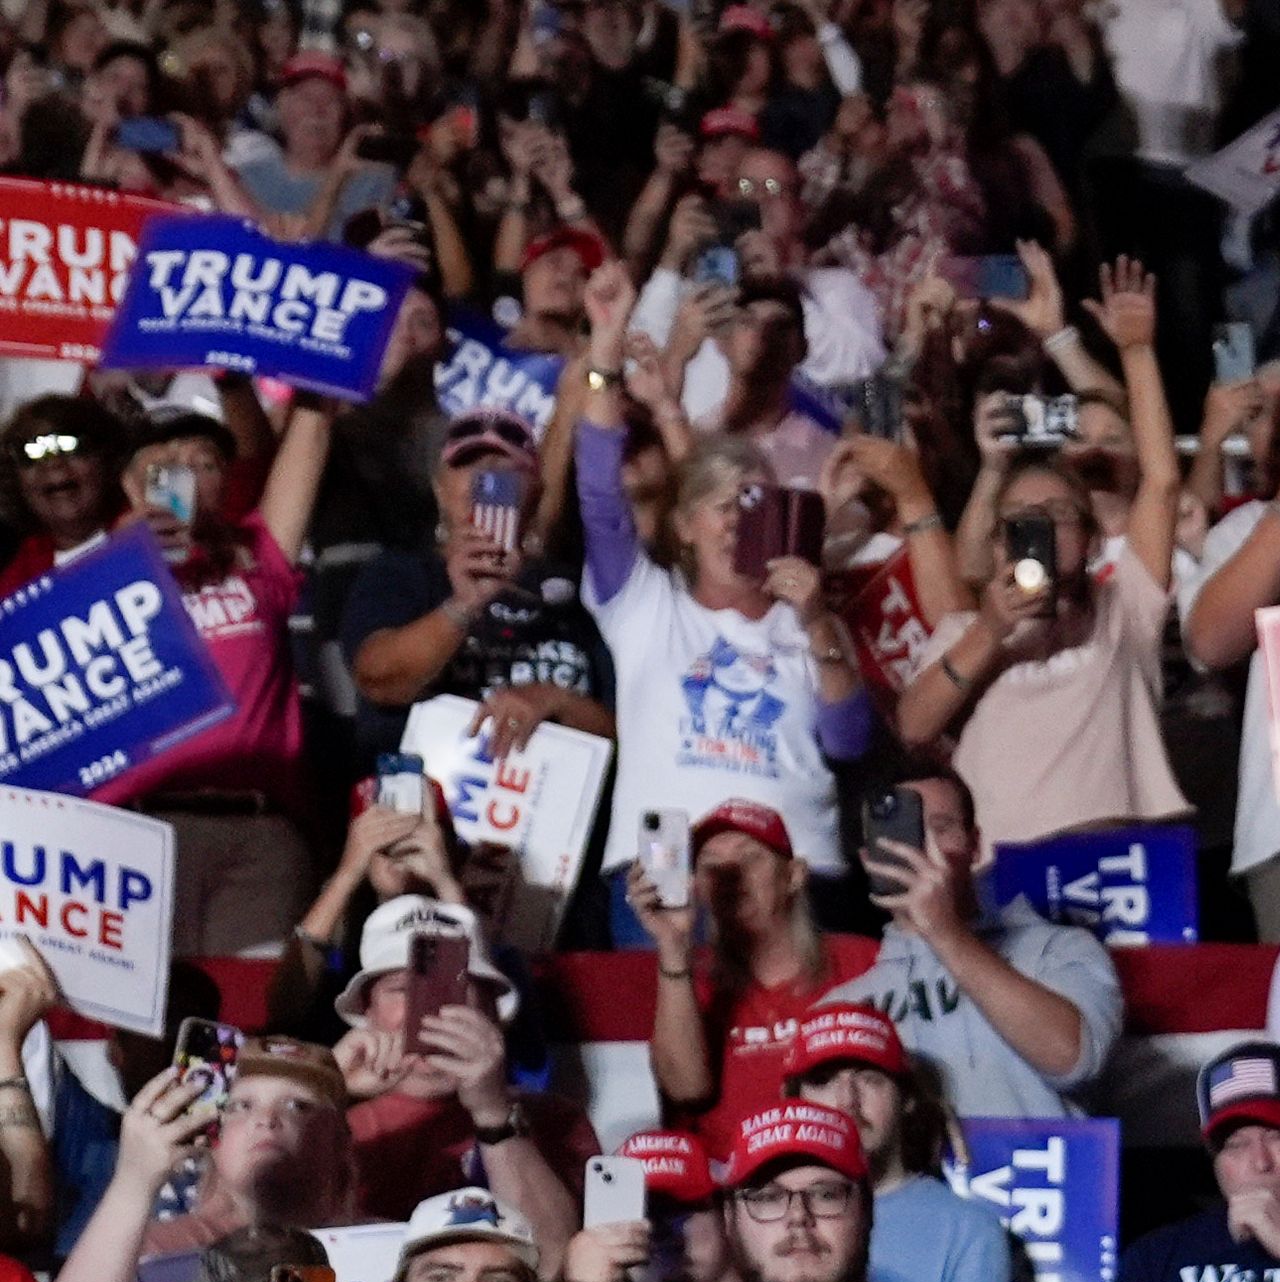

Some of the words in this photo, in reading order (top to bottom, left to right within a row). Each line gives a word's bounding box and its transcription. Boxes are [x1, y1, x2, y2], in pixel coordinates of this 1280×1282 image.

[145, 249, 388, 315] TRUMP
[159, 284, 348, 342] VANCE
[0, 634, 162, 752] ANCE
[0, 888, 125, 952] NCE
[628, 1133, 692, 1154] AMERICA
[741, 1108, 781, 1139] MAKE
[783, 1105, 850, 1136] AMERICA
[747, 1123, 793, 1155] GREAT
[794, 1124, 846, 1150] AGAIN
